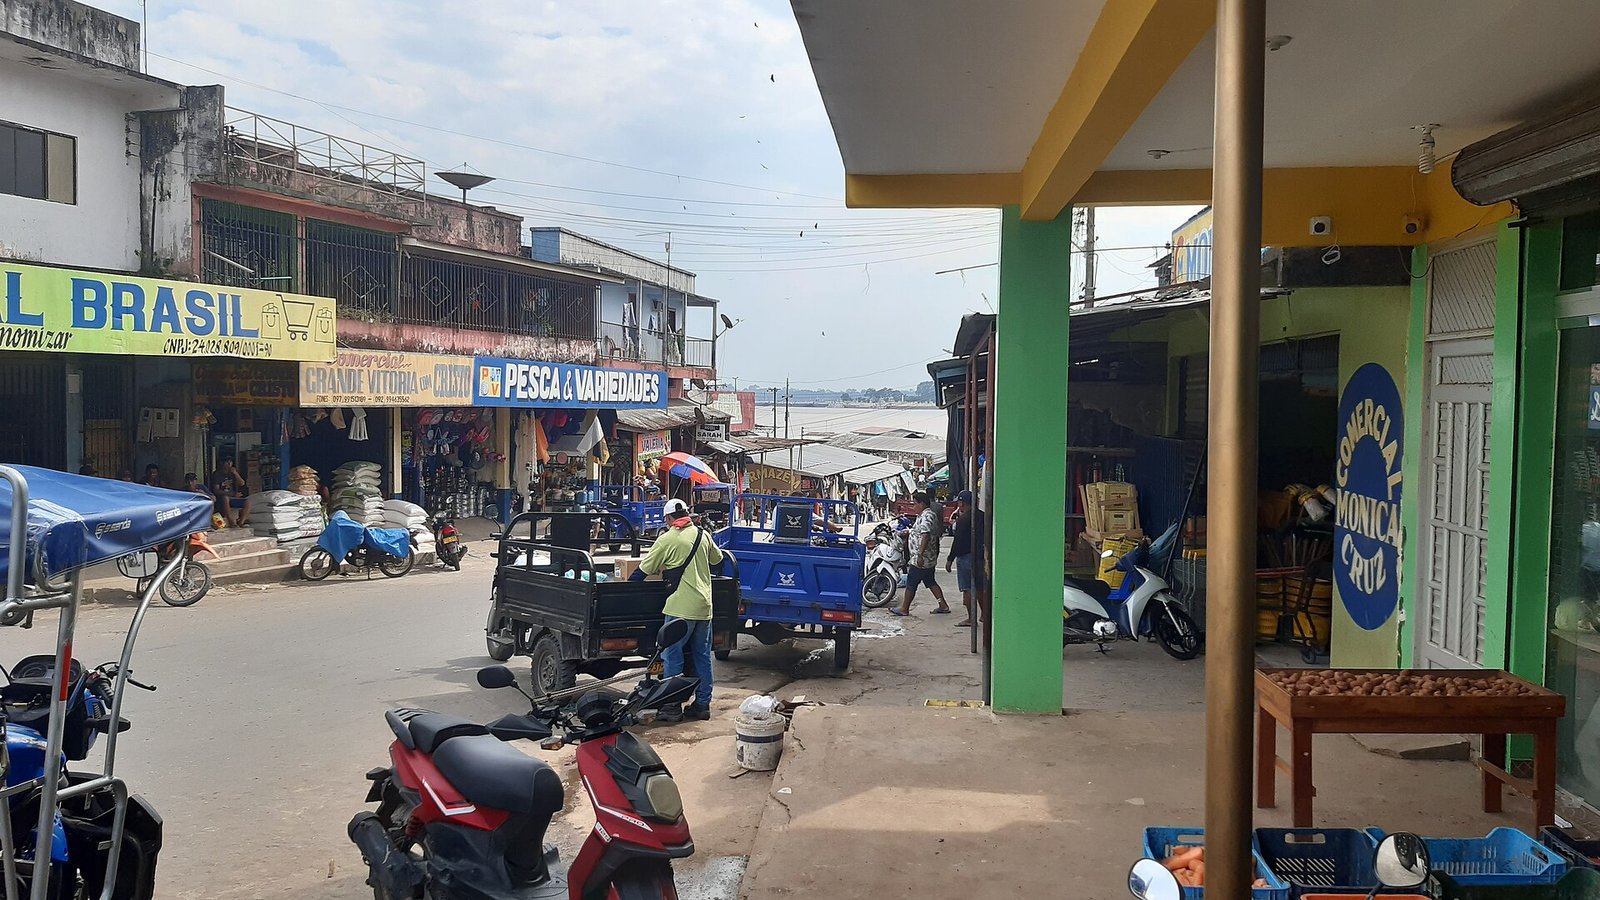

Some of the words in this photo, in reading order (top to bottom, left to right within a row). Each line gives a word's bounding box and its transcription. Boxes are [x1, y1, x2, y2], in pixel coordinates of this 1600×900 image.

[0, 271, 44, 327] L
[70, 277, 259, 338] BRASIL
[305, 367, 364, 394] GRANDE
[367, 369, 419, 394] VITORIA
[433, 363, 471, 398] CRISTO
[505, 363, 560, 401] PESCA
[563, 370, 573, 400] &
[575, 368, 660, 403] VARIEDADES
[697, 431, 722, 439] SARAH
[1336, 398, 1403, 500] COMERCIAL
[1335, 488, 1401, 547] MONICA
[1341, 533, 1387, 595] CRUZ
